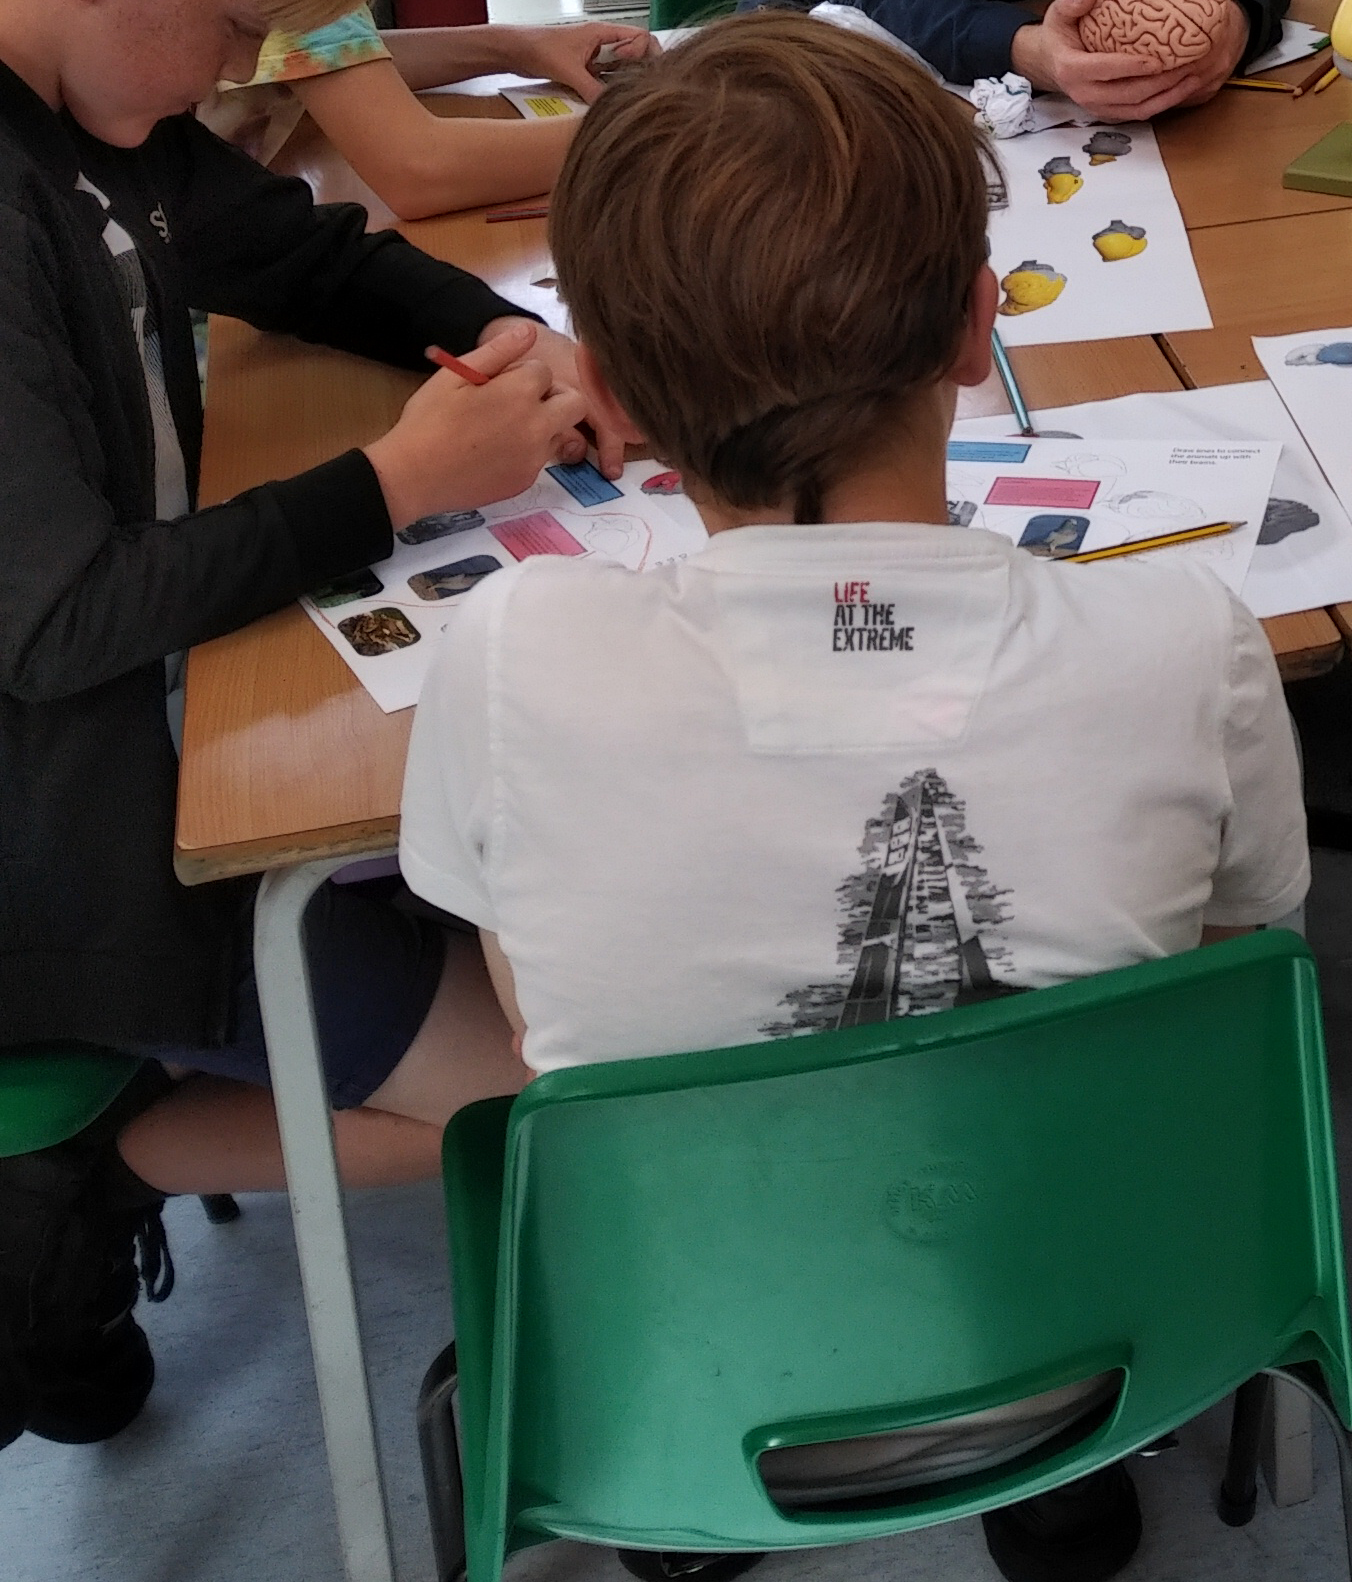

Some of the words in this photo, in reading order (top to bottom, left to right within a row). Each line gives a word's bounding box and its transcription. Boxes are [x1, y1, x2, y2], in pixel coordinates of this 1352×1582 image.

[834, 581, 870, 603] LIFE
[834, 604, 857, 626] AT
[861, 603, 895, 626] THE
[833, 627, 915, 651] EXTREME
